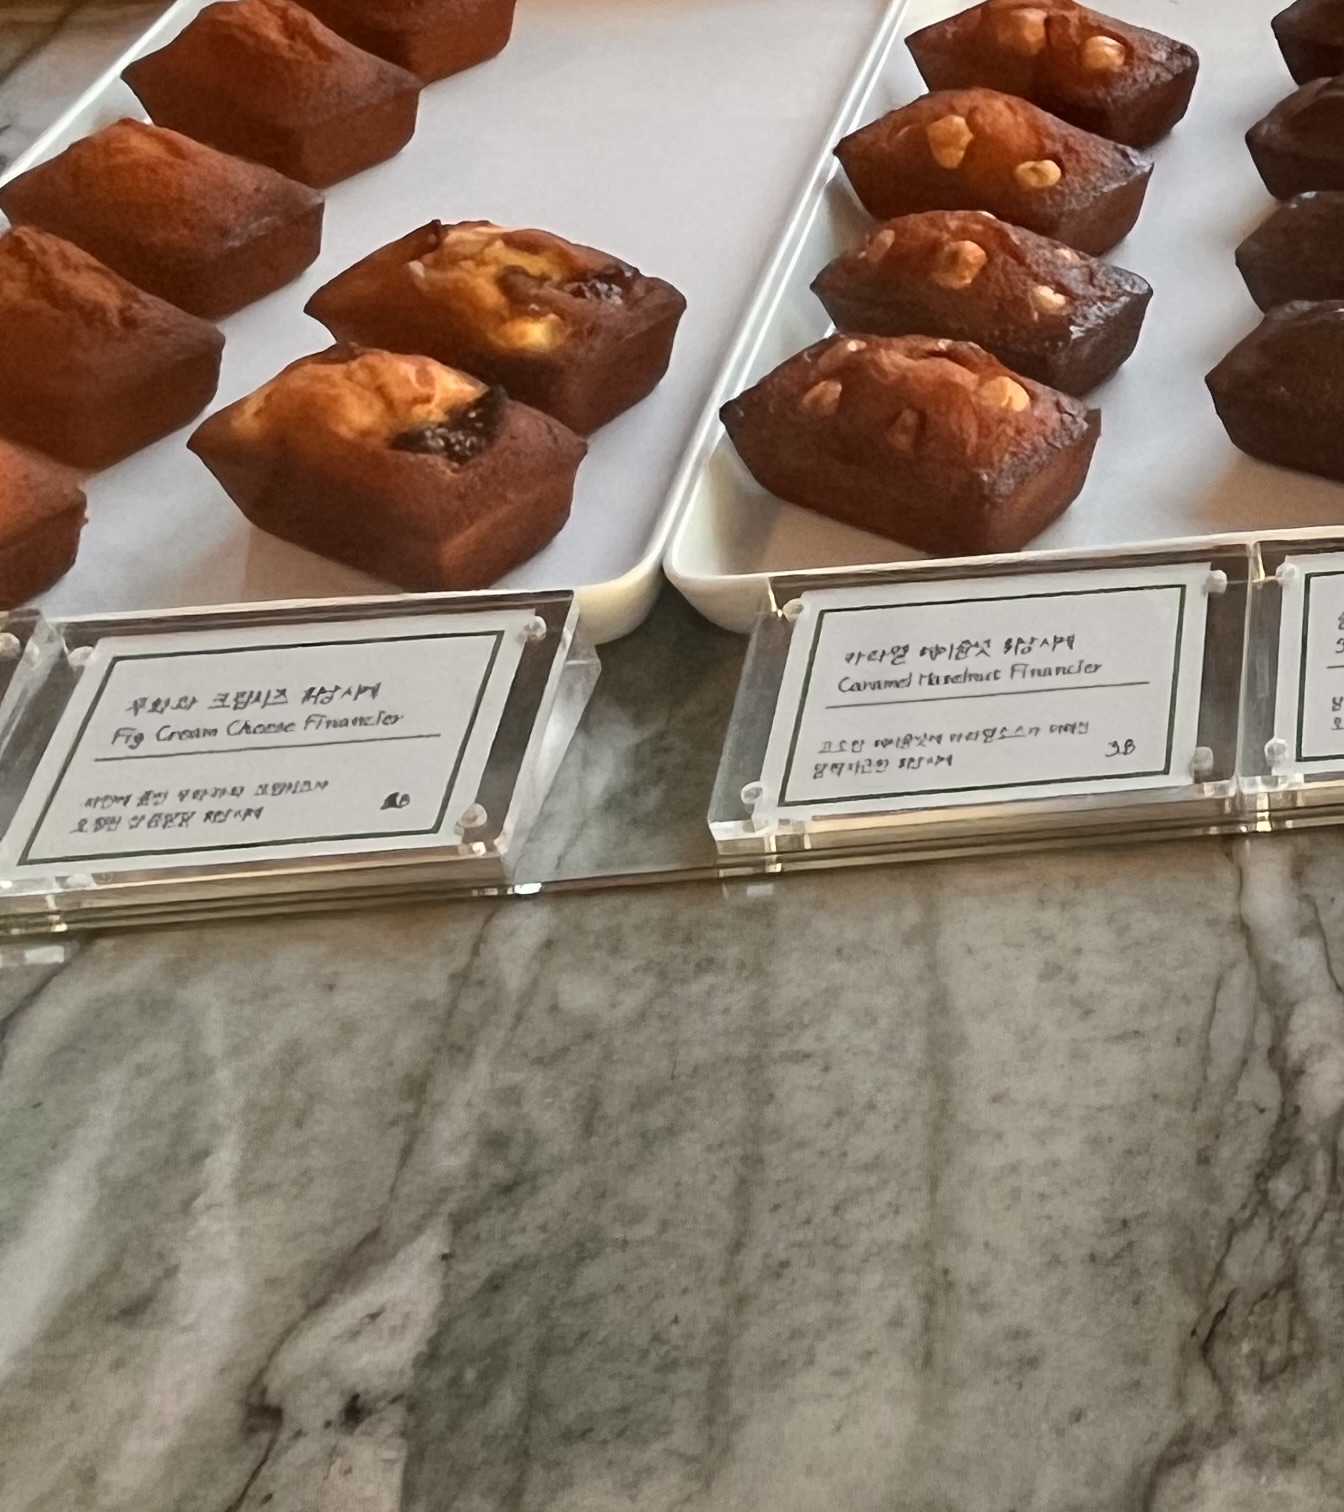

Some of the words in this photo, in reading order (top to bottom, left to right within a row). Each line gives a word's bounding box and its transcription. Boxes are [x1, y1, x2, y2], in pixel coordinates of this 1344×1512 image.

[838, 672, 912, 694] Caramel
[918, 667, 1001, 687] Hazelnut
[1010, 659, 1102, 680] Financier
[111, 727, 145, 750] Fig
[156, 724, 218, 742] Cream
[226, 719, 296, 737] Cheese
[303, 711, 404, 731] Financier
